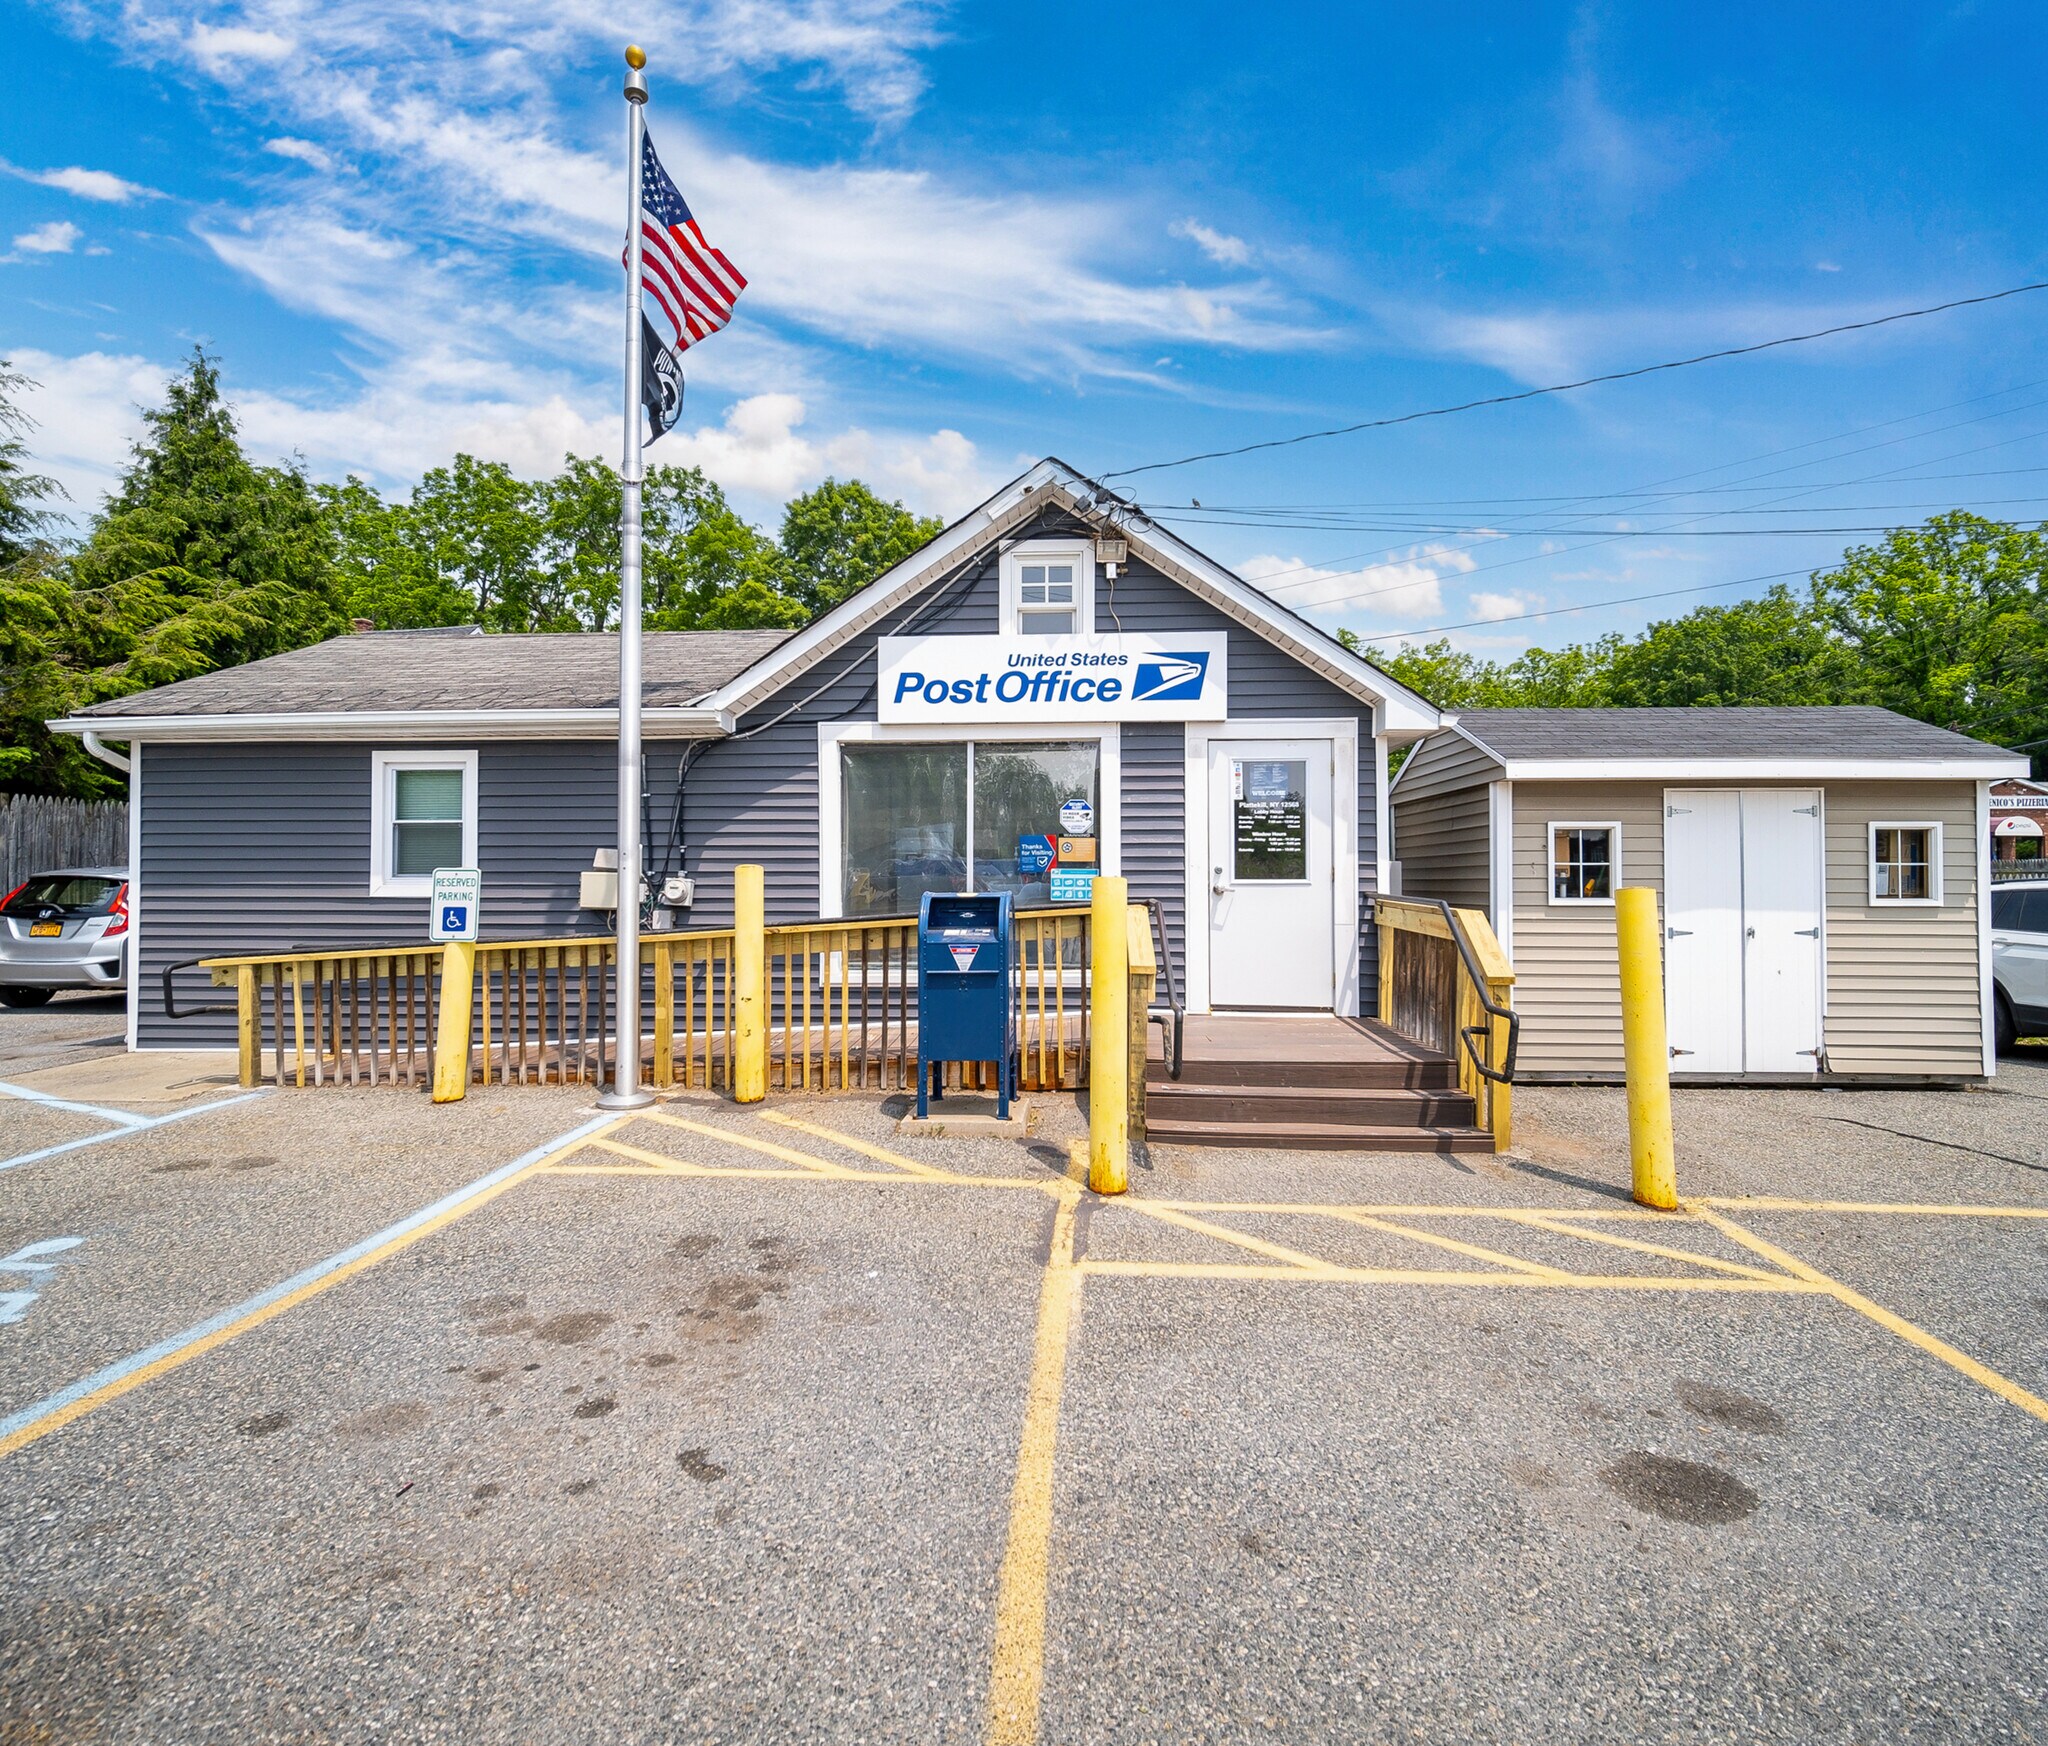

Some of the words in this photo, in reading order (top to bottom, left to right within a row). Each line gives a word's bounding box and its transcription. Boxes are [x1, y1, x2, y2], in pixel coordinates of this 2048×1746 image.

[1007, 653, 1066, 668] United
[1071, 652, 1128, 666] States
[893, 672, 991, 704] Post
[995, 670, 1122, 703] Office
[435, 877, 476, 887] RESERVED
[438, 891, 473, 901] PARKING
